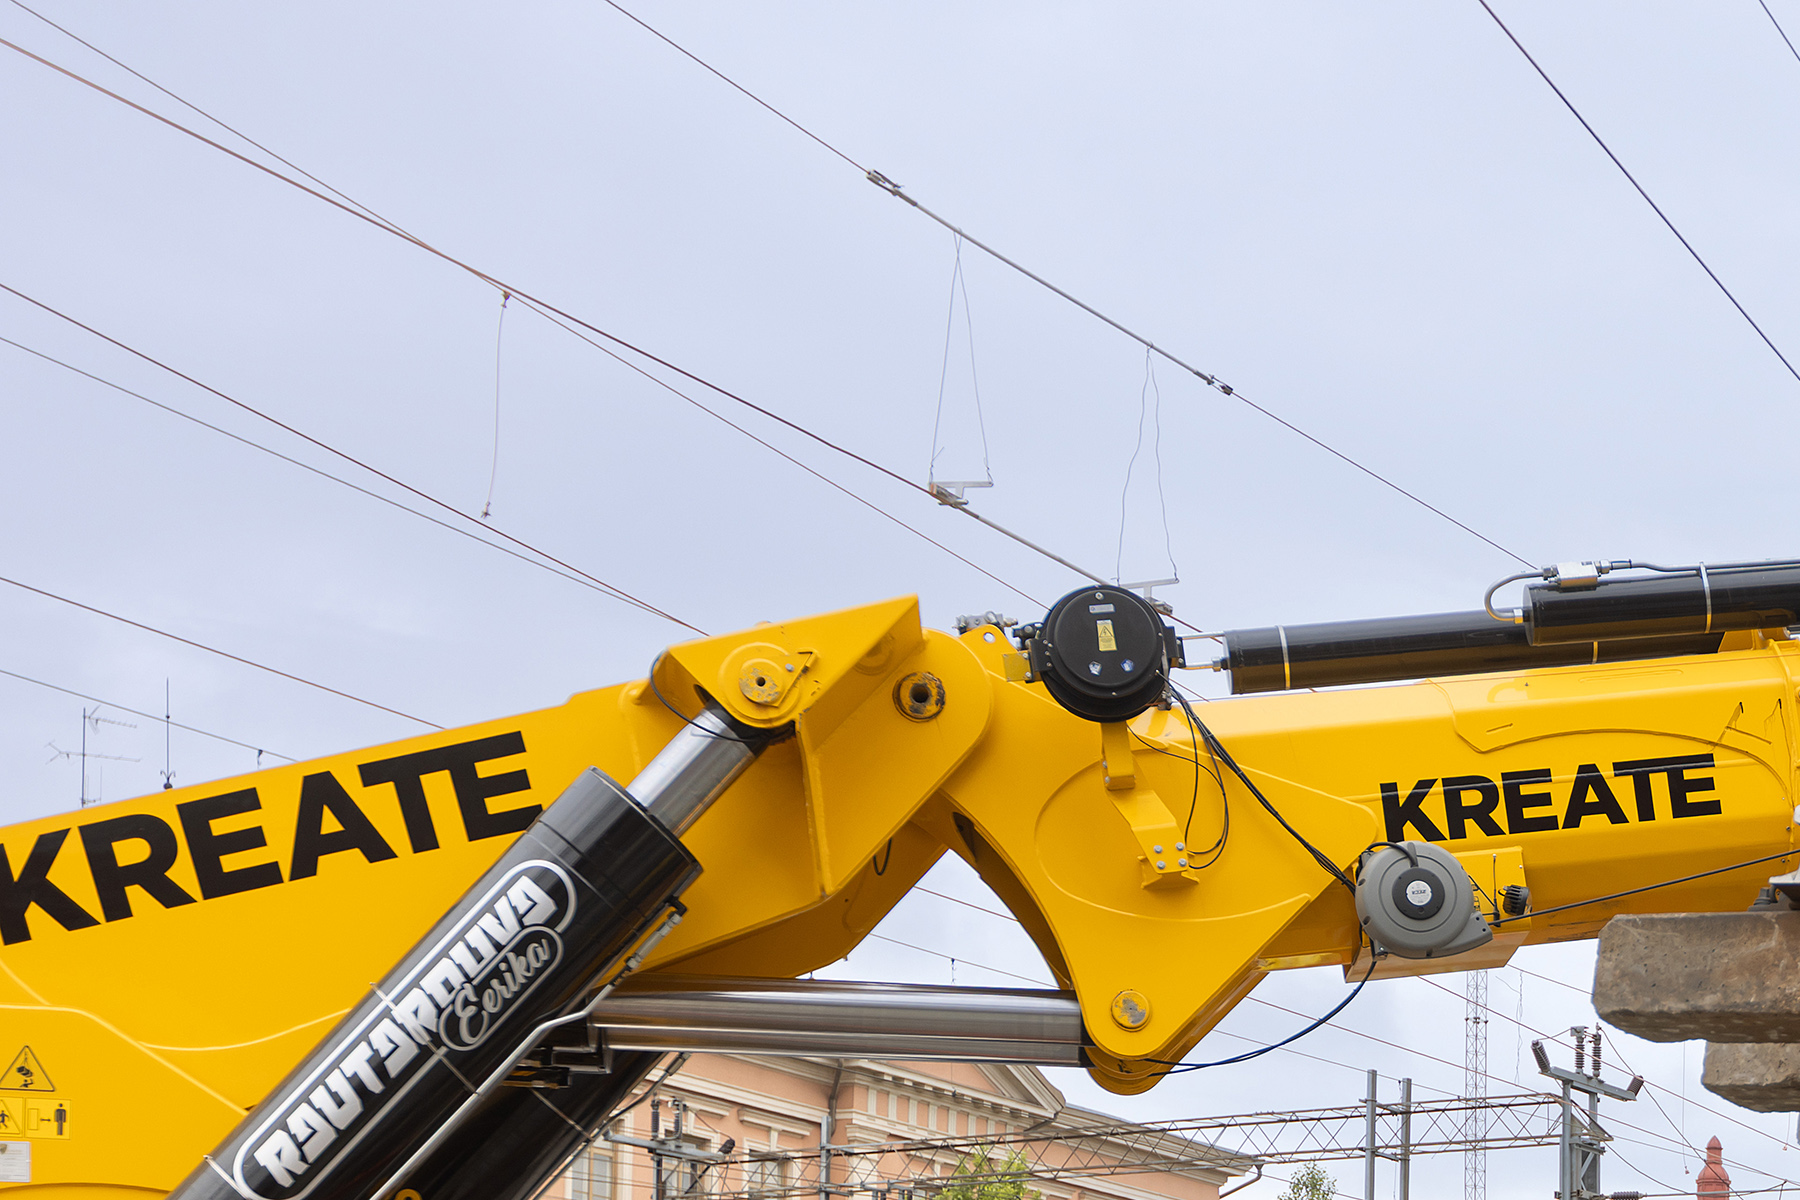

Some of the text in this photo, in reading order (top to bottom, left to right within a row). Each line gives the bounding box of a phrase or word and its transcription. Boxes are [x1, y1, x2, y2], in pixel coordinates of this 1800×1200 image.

[0, 731, 545, 946] KREATE
[1379, 753, 1722, 842] KREATE
[253, 875, 558, 1188] RAUTAROUVA
[453, 938, 551, 1045] Eerika
